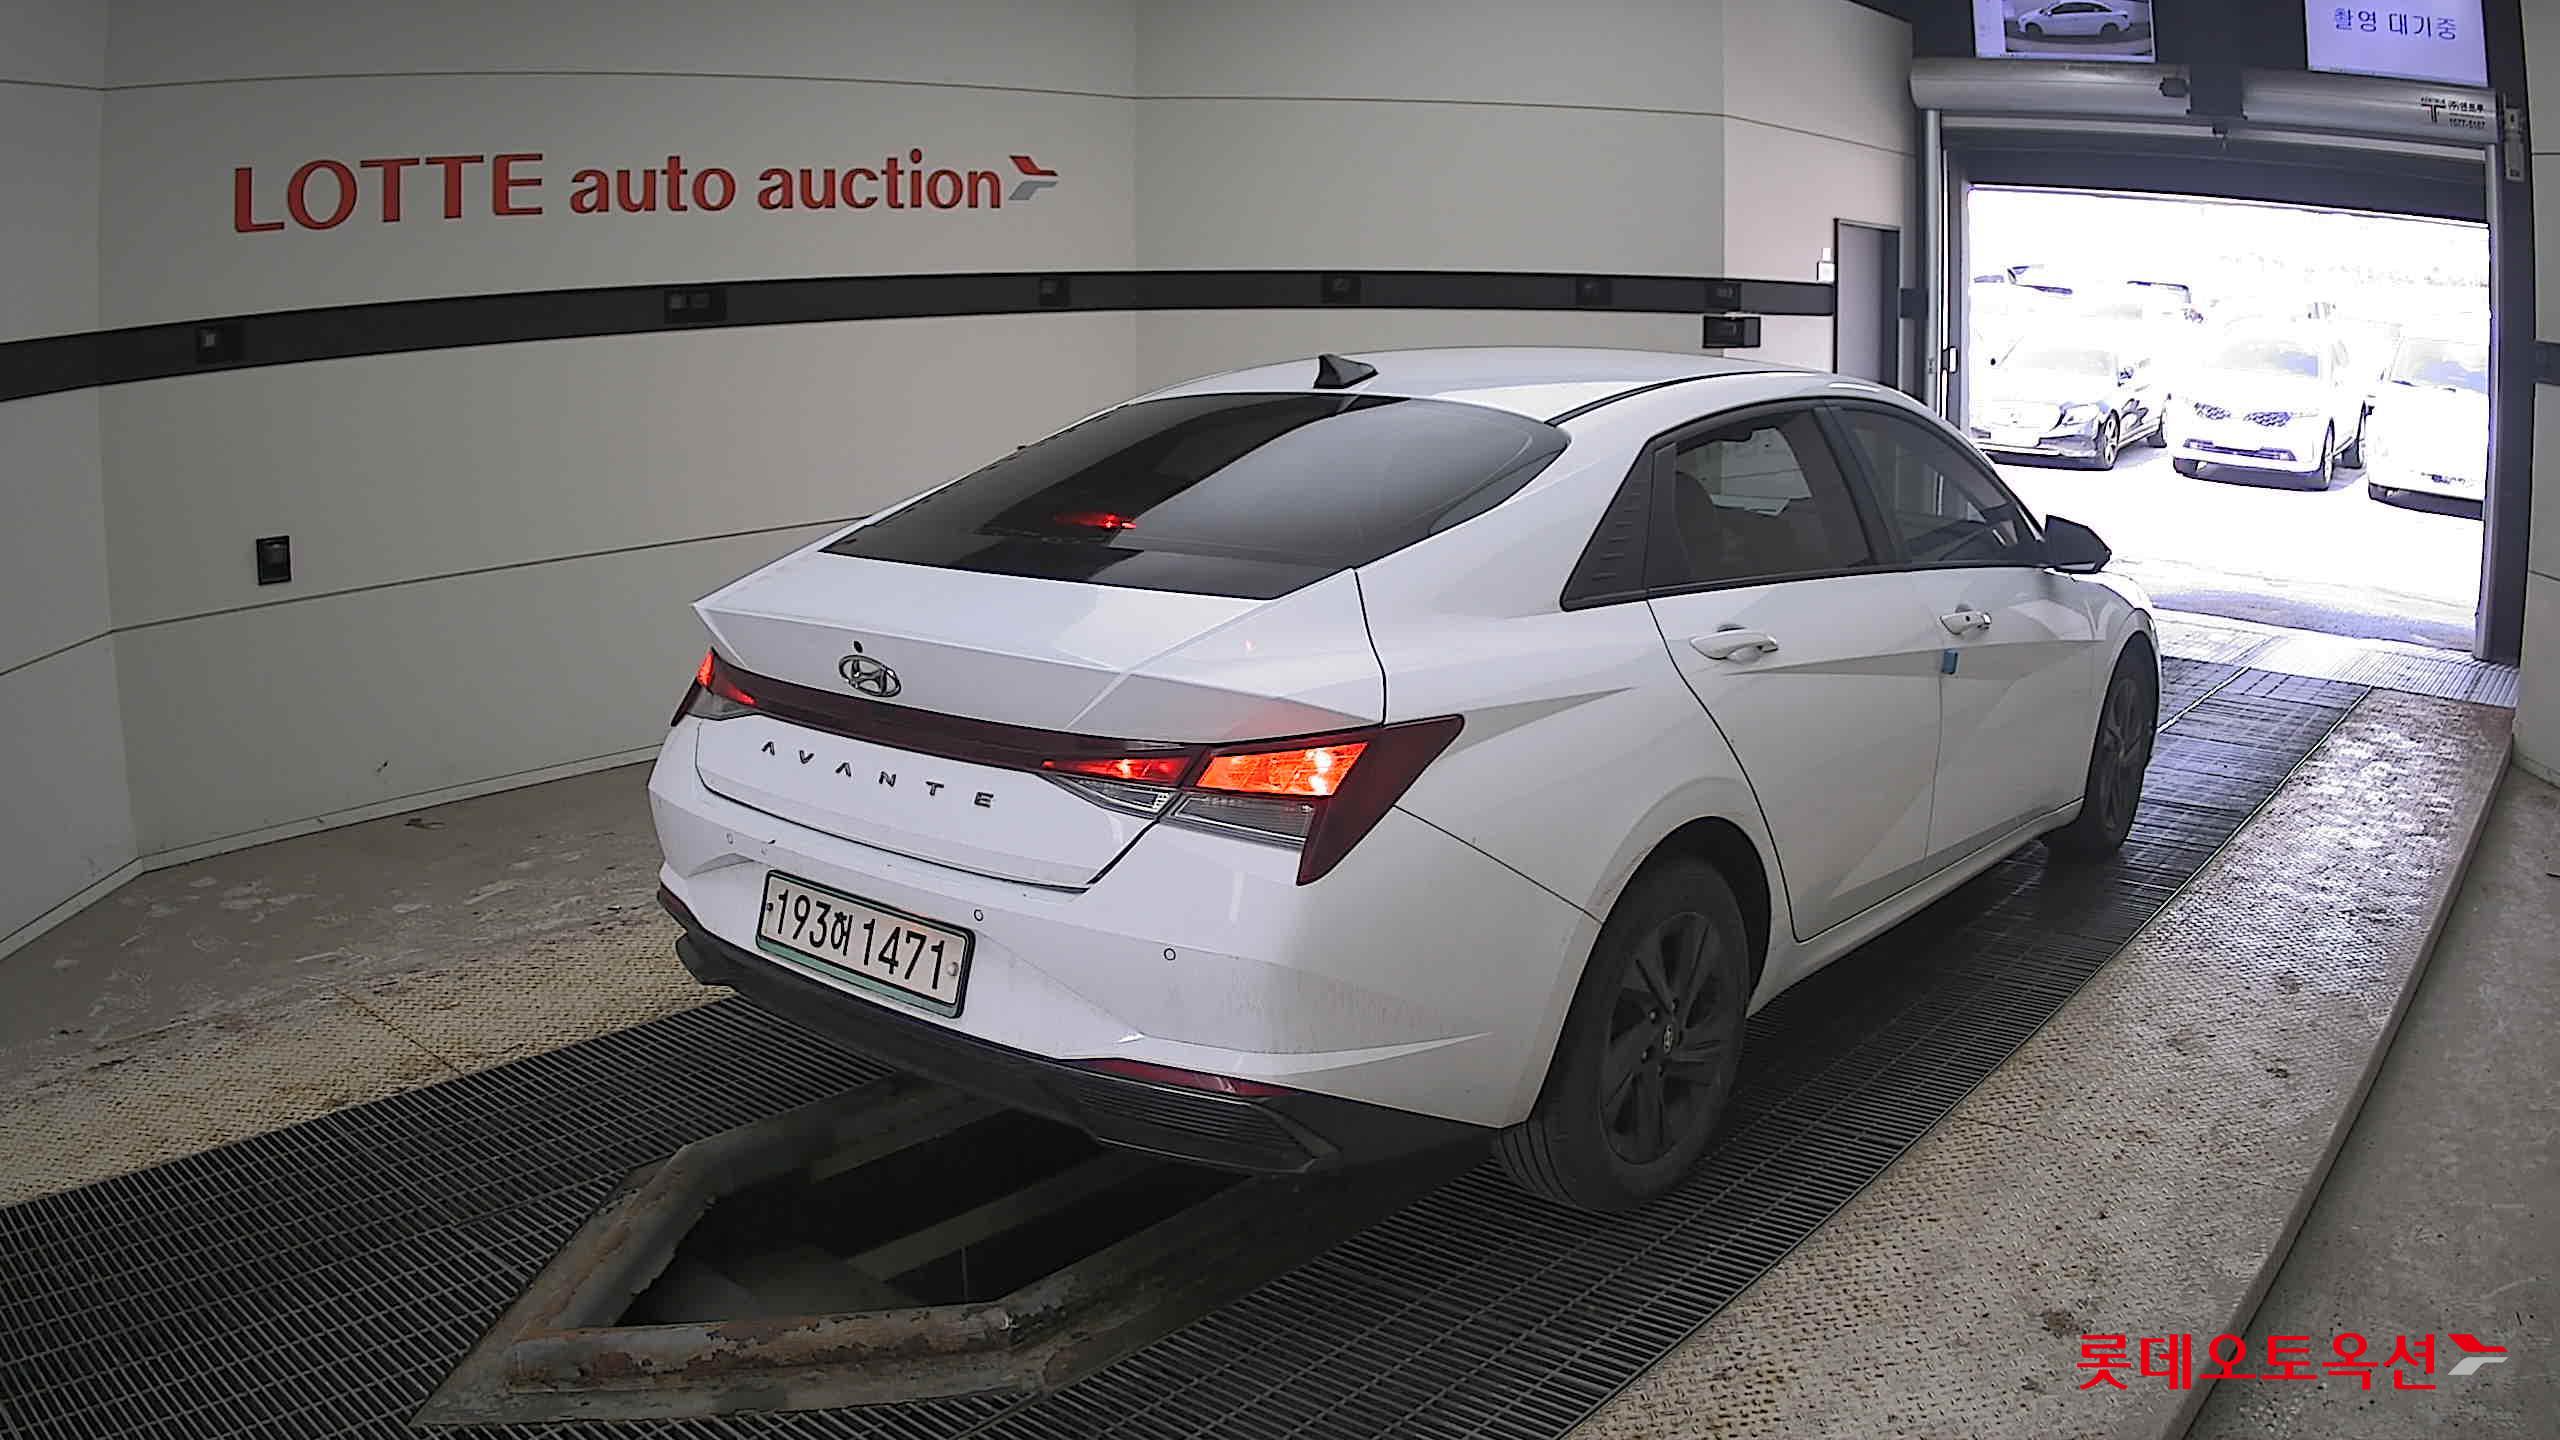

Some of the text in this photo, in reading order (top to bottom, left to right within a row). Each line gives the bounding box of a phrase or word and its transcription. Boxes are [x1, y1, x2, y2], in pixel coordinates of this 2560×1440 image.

[2388, 12, 2457, 41] 대기중
[234, 147, 1002, 233] LOTTE auto auction
[761, 740, 995, 808] AVANTE
